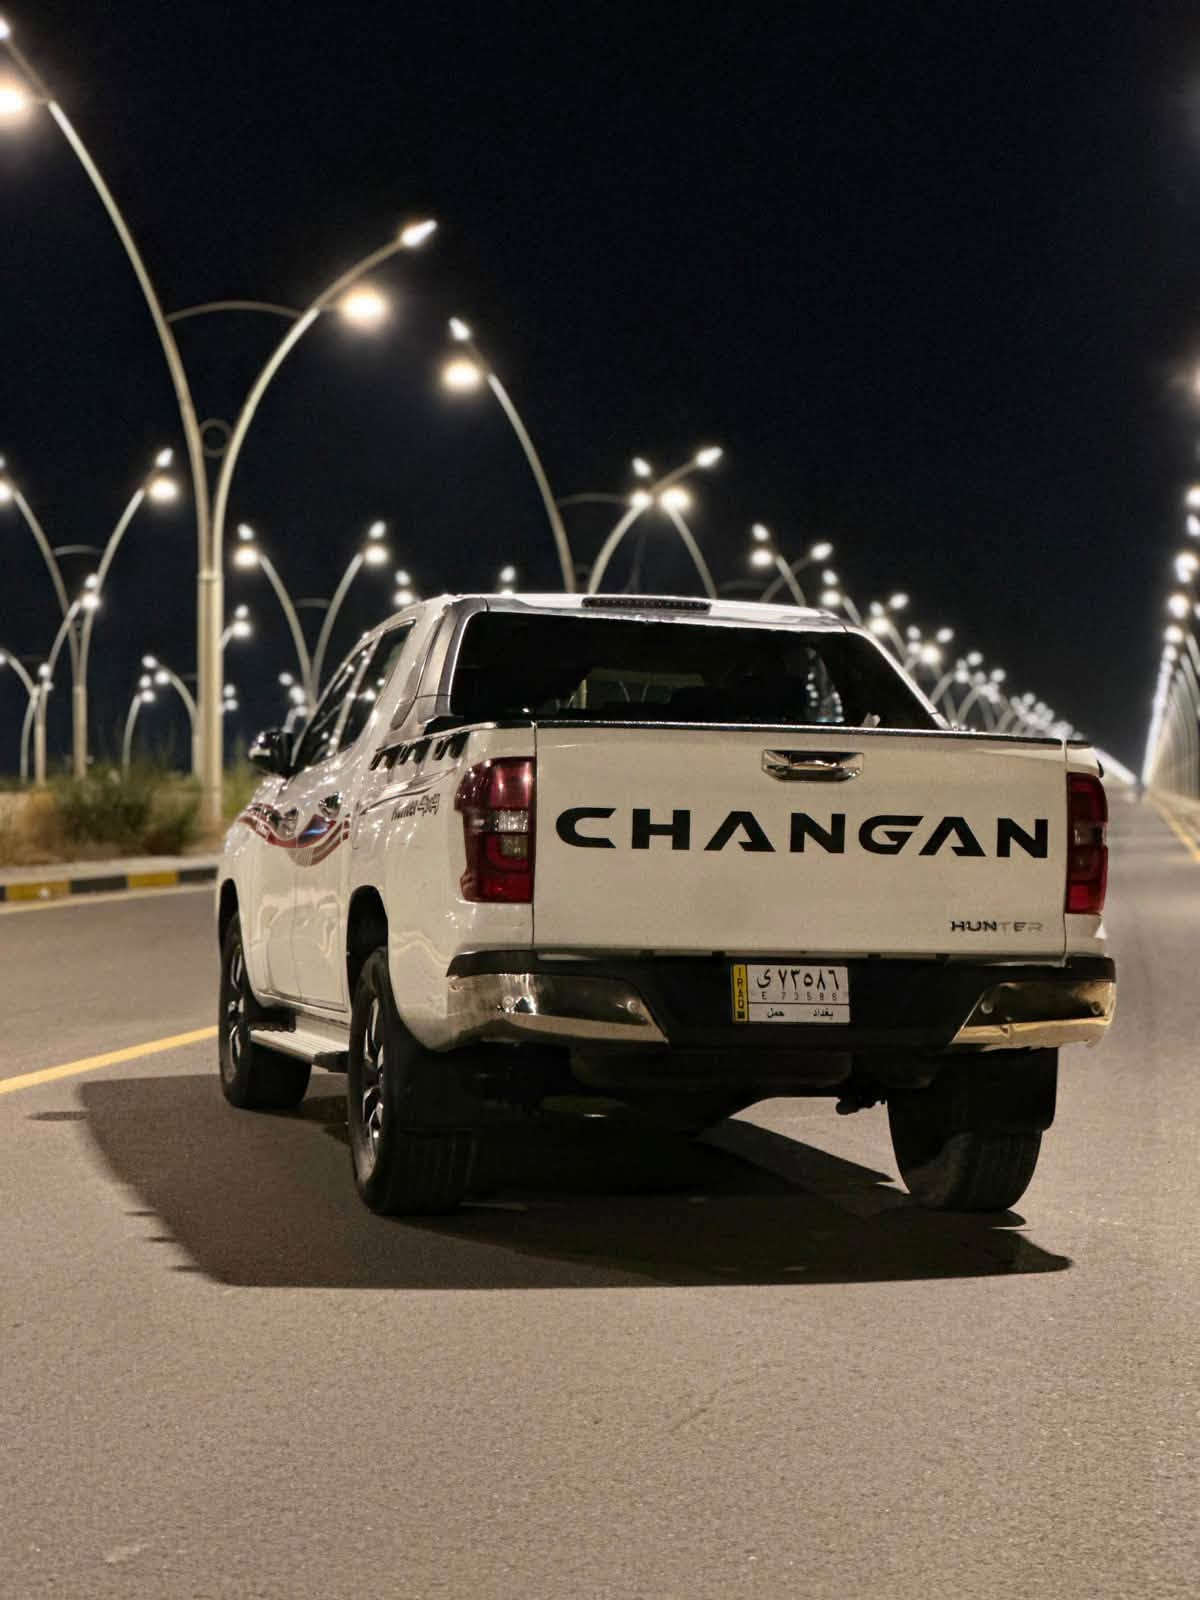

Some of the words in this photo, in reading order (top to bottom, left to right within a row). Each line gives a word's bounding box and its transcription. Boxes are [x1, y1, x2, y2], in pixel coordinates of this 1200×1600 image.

[555, 807, 1049, 858] CHANGAN
[951, 920, 1042, 932] HUNTER
[737, 967, 745, 1009] IRAQ
[778, 969, 840, 991] ٧٣٥٨٦
